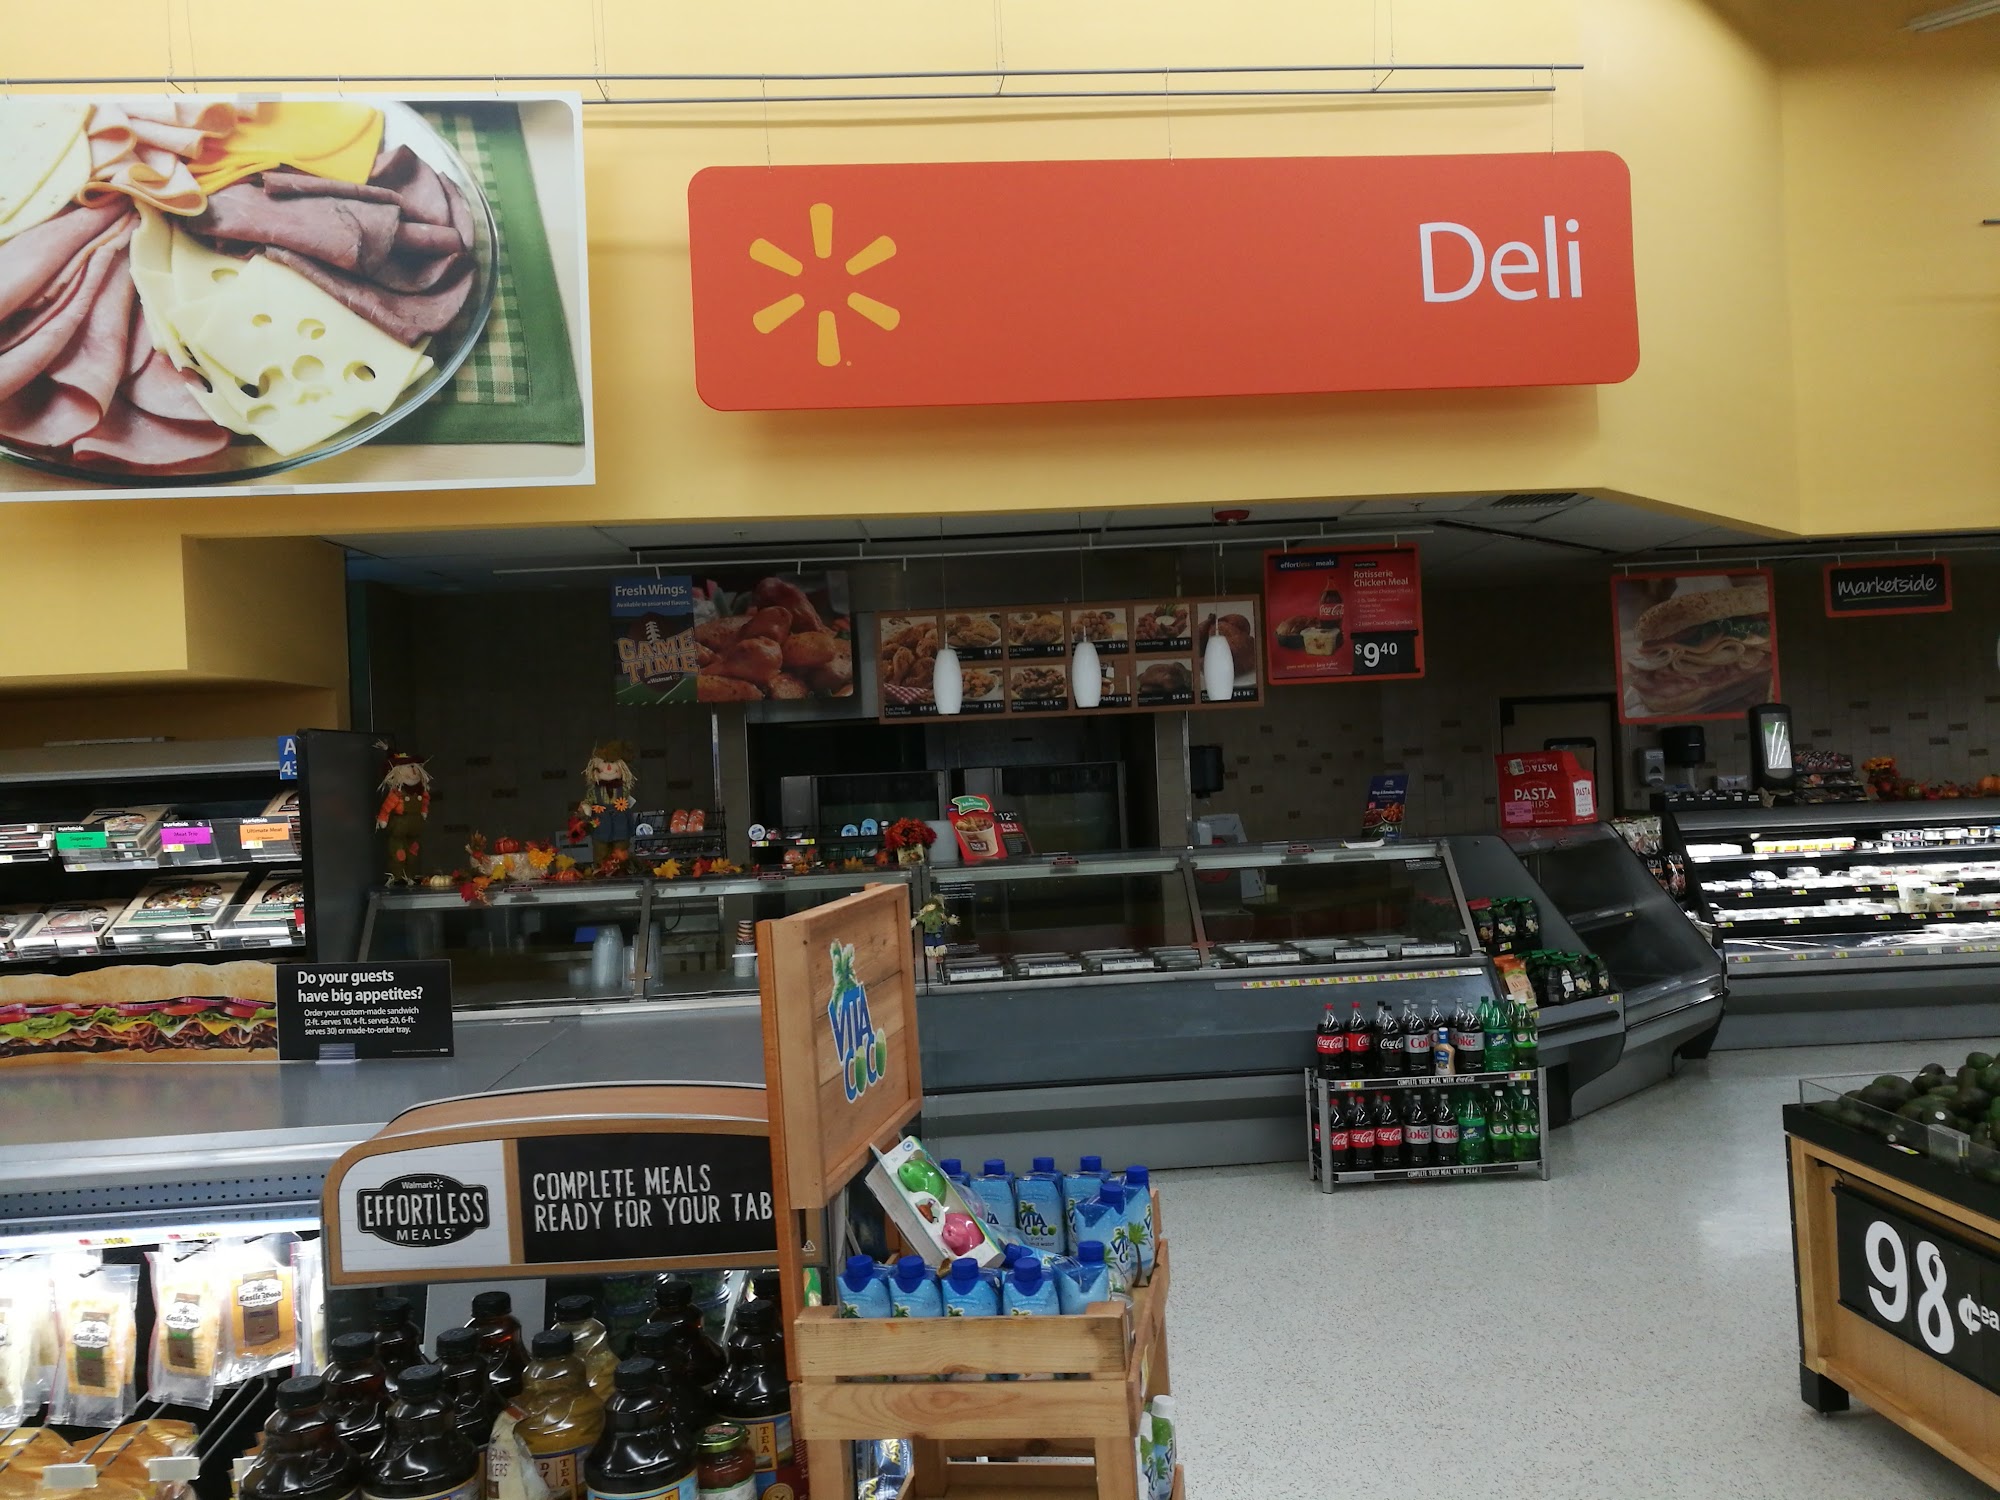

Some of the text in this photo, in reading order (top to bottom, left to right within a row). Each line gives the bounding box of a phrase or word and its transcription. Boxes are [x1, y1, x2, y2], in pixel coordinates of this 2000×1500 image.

[1419, 215, 1583, 303] Deli
[1353, 570, 1393, 579] Rotisserie
[1353, 577, 1409, 587] Chicken Meal
[615, 584, 688, 598] Fresh Wings.
[618, 626, 697, 661] GAME
[622, 652, 700, 686] TIME
[1532, 763, 1558, 773] PASTA
[1514, 787, 1556, 801] PASTA
[1576, 788, 1590, 796] PASTA
[297, 970, 395, 988] Do your guests
[298, 986, 424, 1005] have big appetites?
[304, 1006, 420, 1018] Order your custom-made sandwich
[321, 1018, 342, 1026] serves
[342, 1018, 352, 1026] 10,
[352, 1017, 367, 1026] 4-ft.
[367, 1017, 389, 1025] serves
[390, 1017, 400, 1025] 20,
[401, 1016, 416, 1024] 6-ft.
[326, 1027, 337, 1036] 30)
[346, 1026, 395, 1035] made-to-order
[396, 1026, 412, 1035] tray.
[401, 1181, 432, 1190] Walmart
[533, 1164, 712, 1202] COMPLETE MEALS
[363, 1191, 485, 1228] EFFORTLESS
[535, 1201, 603, 1233] READY
[615, 1198, 653, 1229] FOR
[663, 1194, 722, 1225] YOUR
[239, 1293, 261, 1302] Castle
[261, 1291, 282, 1300] Wood
[166, 1314, 199, 1324] Castle Wood
[759, 1425, 770, 1453] TEA
[559, 1458, 571, 1487] TEA
